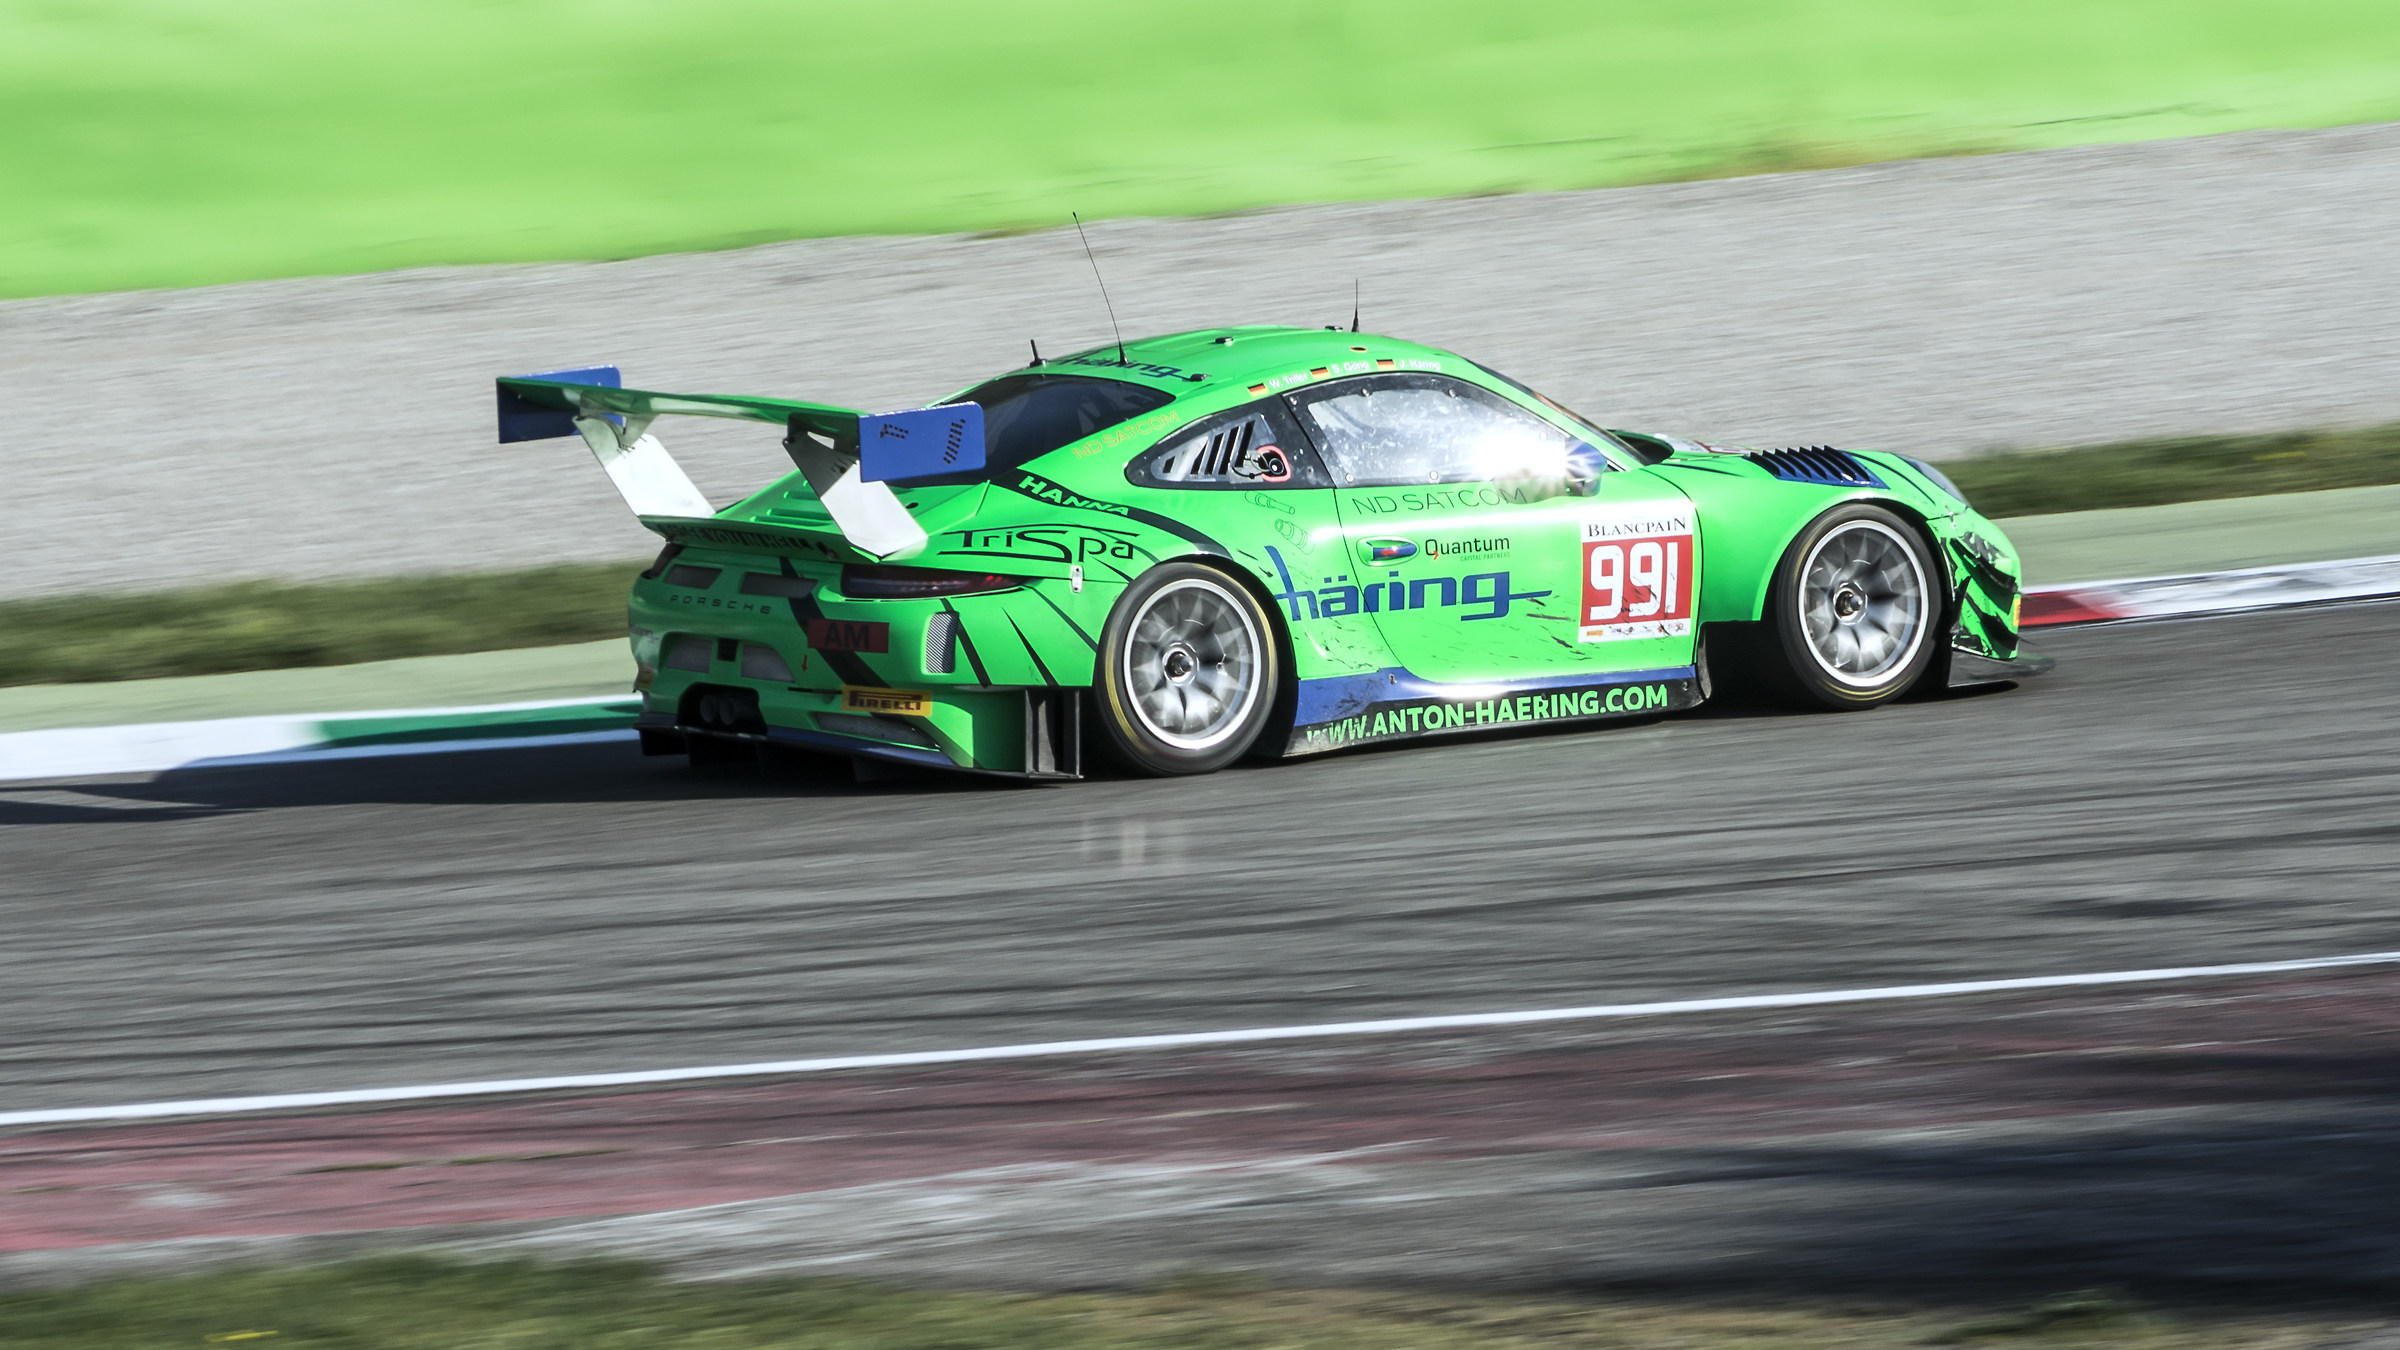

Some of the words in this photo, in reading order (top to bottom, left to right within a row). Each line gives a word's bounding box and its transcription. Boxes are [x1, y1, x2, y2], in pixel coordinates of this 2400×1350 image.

[1072, 439, 1103, 459] ND
[1102, 411, 1181, 448] SATCOM
[1018, 475, 1129, 516] HANNA
[1352, 495, 1398, 515] ND
[1402, 487, 1528, 511] SATCOM
[1588, 517, 1687, 537] BLANCPAIN
[937, 523, 1140, 563] TriSpa
[1425, 537, 1511, 560] Quantum
[1264, 545, 1553, 622] häring
[1589, 541, 1678, 621] 991
[670, 594, 772, 615] PORSCHE
[824, 622, 870, 650] AM
[849, 690, 923, 711] PIRELLI
